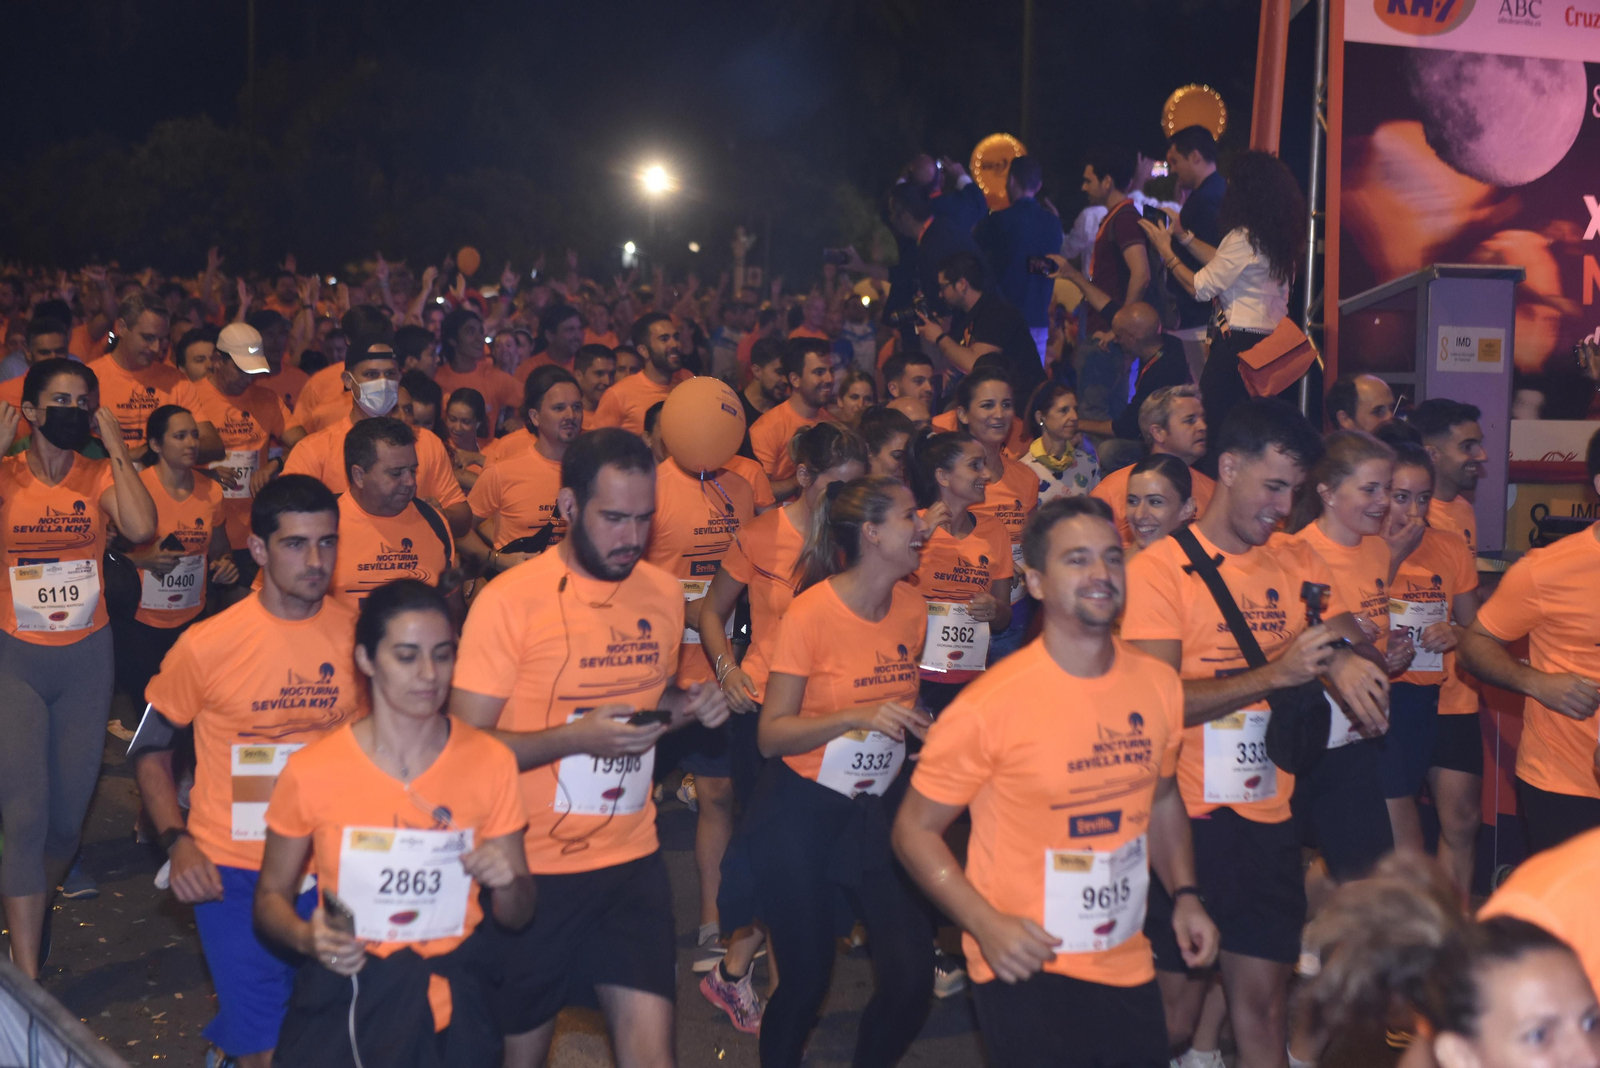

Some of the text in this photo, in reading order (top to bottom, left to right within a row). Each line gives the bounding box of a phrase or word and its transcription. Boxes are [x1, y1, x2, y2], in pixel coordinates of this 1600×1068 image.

[1499, 0, 1542, 18] ABC
[1455, 337, 1471, 347] IMD
[13, 524, 61, 533] SEVILLA
[694, 527, 723, 535] SEVILLA
[357, 563, 395, 571] SEVILLA
[953, 567, 989, 577] NOCTURNA
[161, 574, 194, 588] 10400
[934, 572, 971, 583] SEVILLA
[38, 585, 79, 603] 6119
[941, 625, 974, 643] 5362
[607, 642, 659, 653] NOCTURNA
[580, 655, 633, 668] SEVILLA
[854, 674, 896, 688] SEVILLA
[280, 686, 339, 697] NOCTURNA
[252, 697, 306, 711] SEVILLA
[1093, 738, 1151, 753] NOCTURNA
[852, 752, 893, 770] 3332
[1067, 754, 1121, 773] SEVILLA
[379, 868, 442, 895] 2863
[1082, 877, 1130, 910] 9615
